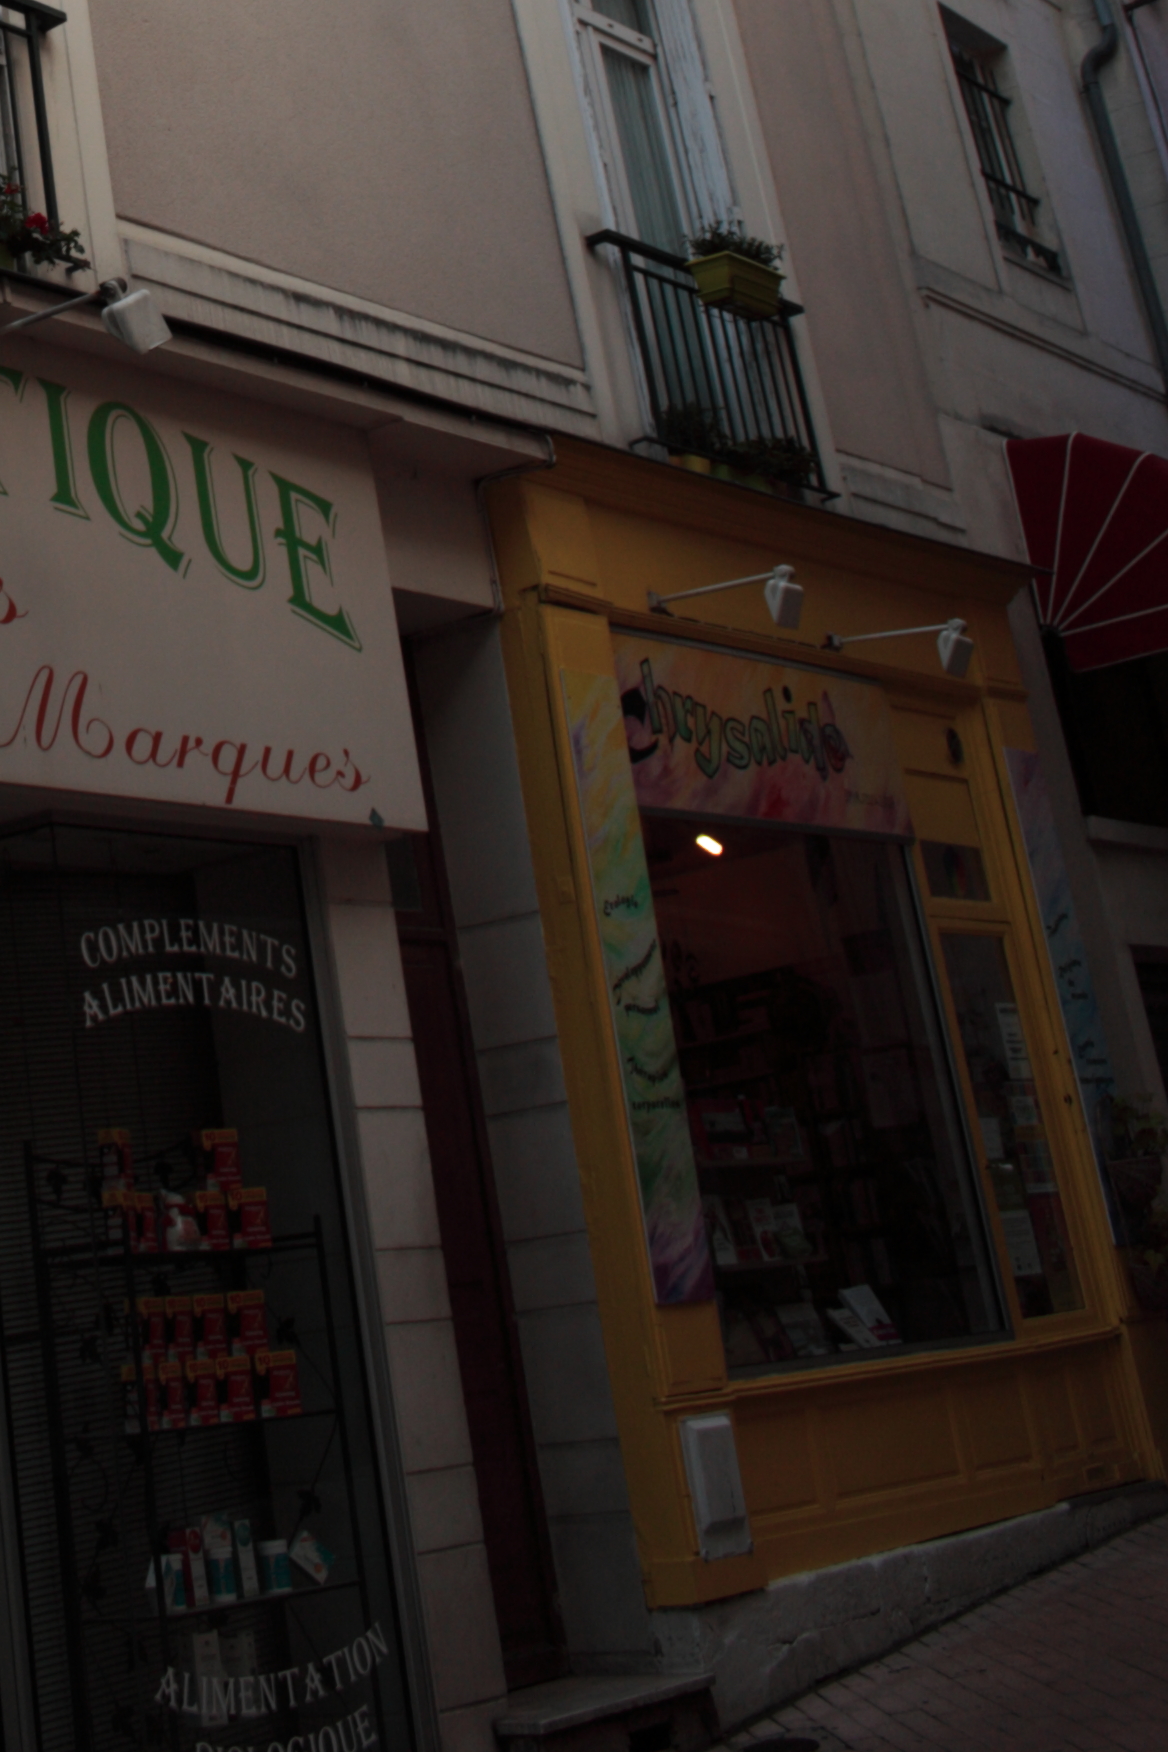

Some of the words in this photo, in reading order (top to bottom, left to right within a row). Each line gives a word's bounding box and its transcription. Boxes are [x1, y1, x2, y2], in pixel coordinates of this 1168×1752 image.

[79, 917, 299, 980] COMPLEMENTS
[81, 970, 307, 1035] ALIMENTAIRES
[152, 1619, 390, 1718] ALIMENTATION
